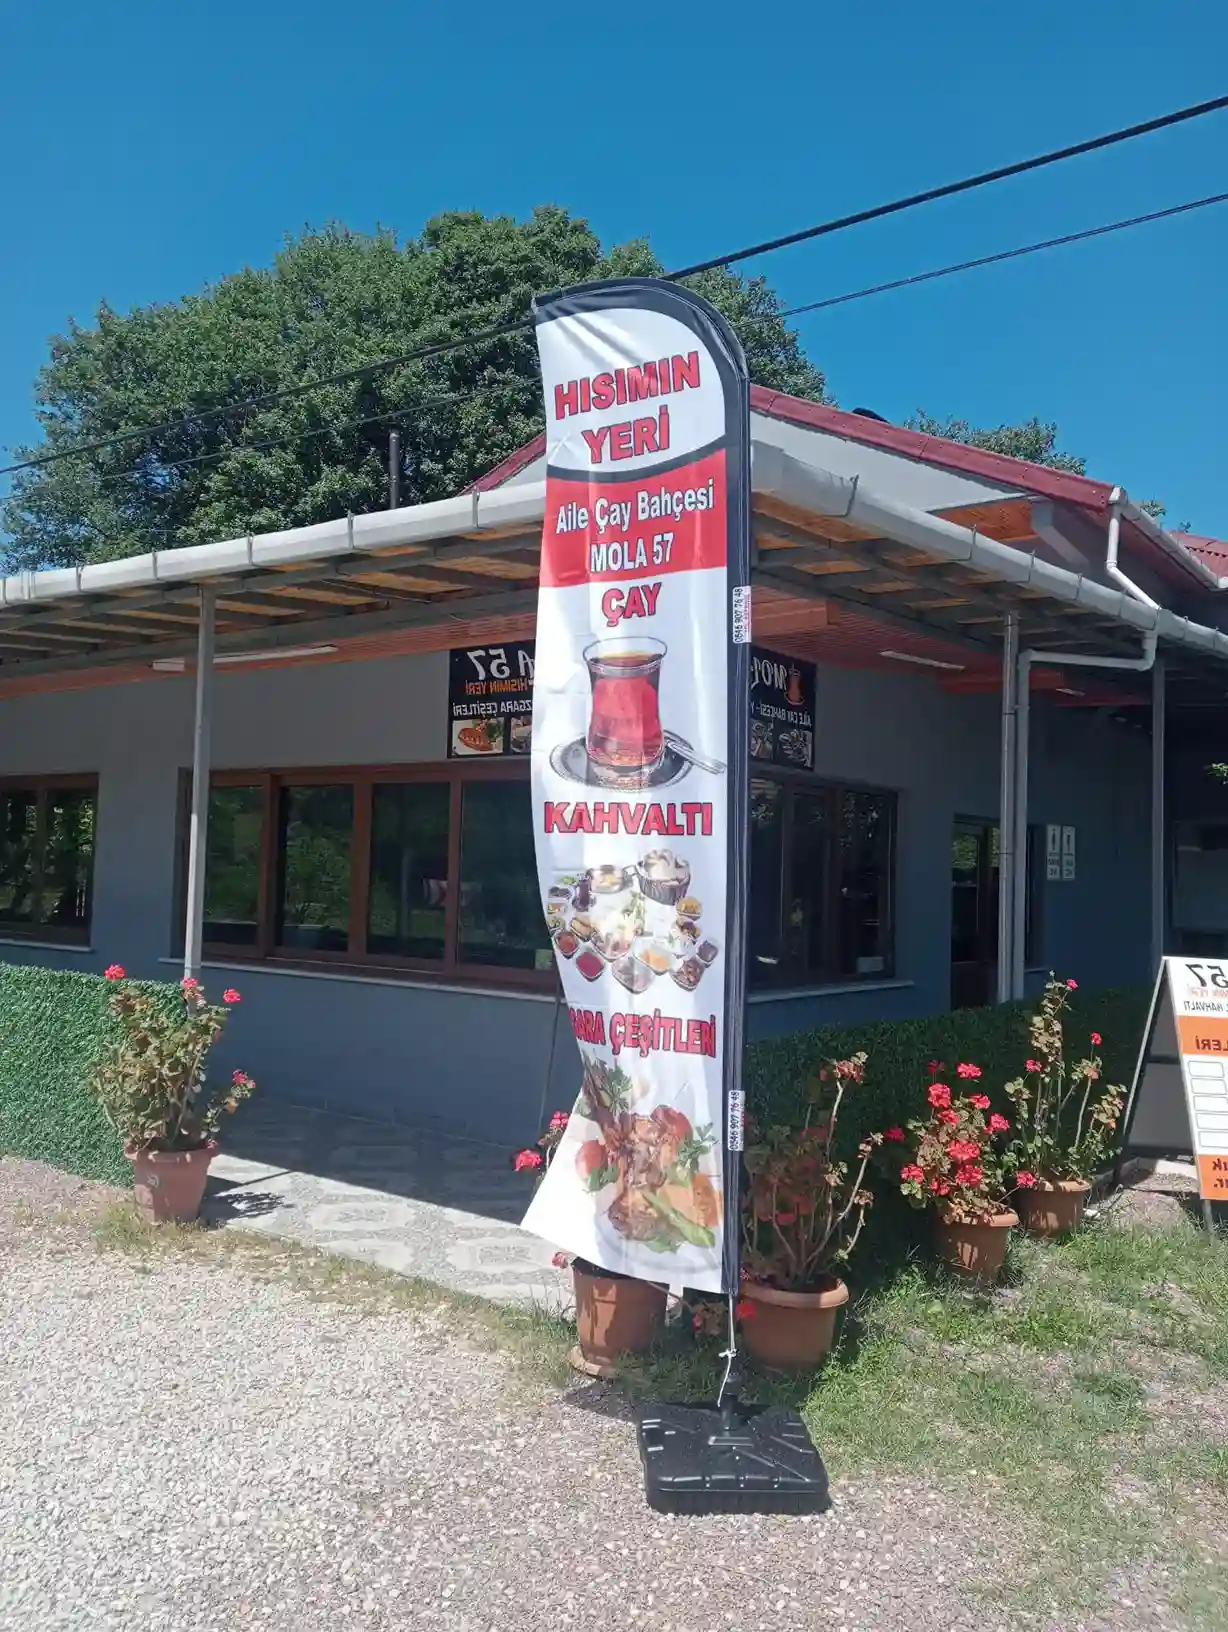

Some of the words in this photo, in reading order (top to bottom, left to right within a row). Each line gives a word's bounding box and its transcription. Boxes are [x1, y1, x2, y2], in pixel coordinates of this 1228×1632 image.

[554, 350, 701, 420] HISIMIN
[582, 404, 670, 464] YERİ
[556, 500, 589, 534] Aile
[595, 496, 632, 535] Çay
[637, 478, 714, 522] Bahçesi
[590, 541, 649, 573] MOLA
[652, 532, 674, 564] 57
[601, 582, 662, 628] ÇAY
[544, 801, 713, 836] KAHVALTI
[609, 1008, 717, 1059] ÇEŞİTLERİ
[730, 1091, 739, 1101] 48
[730, 1103, 739, 1112] 76
[729, 1114, 739, 1129] 907
[729, 1130, 739, 1150] 0546
